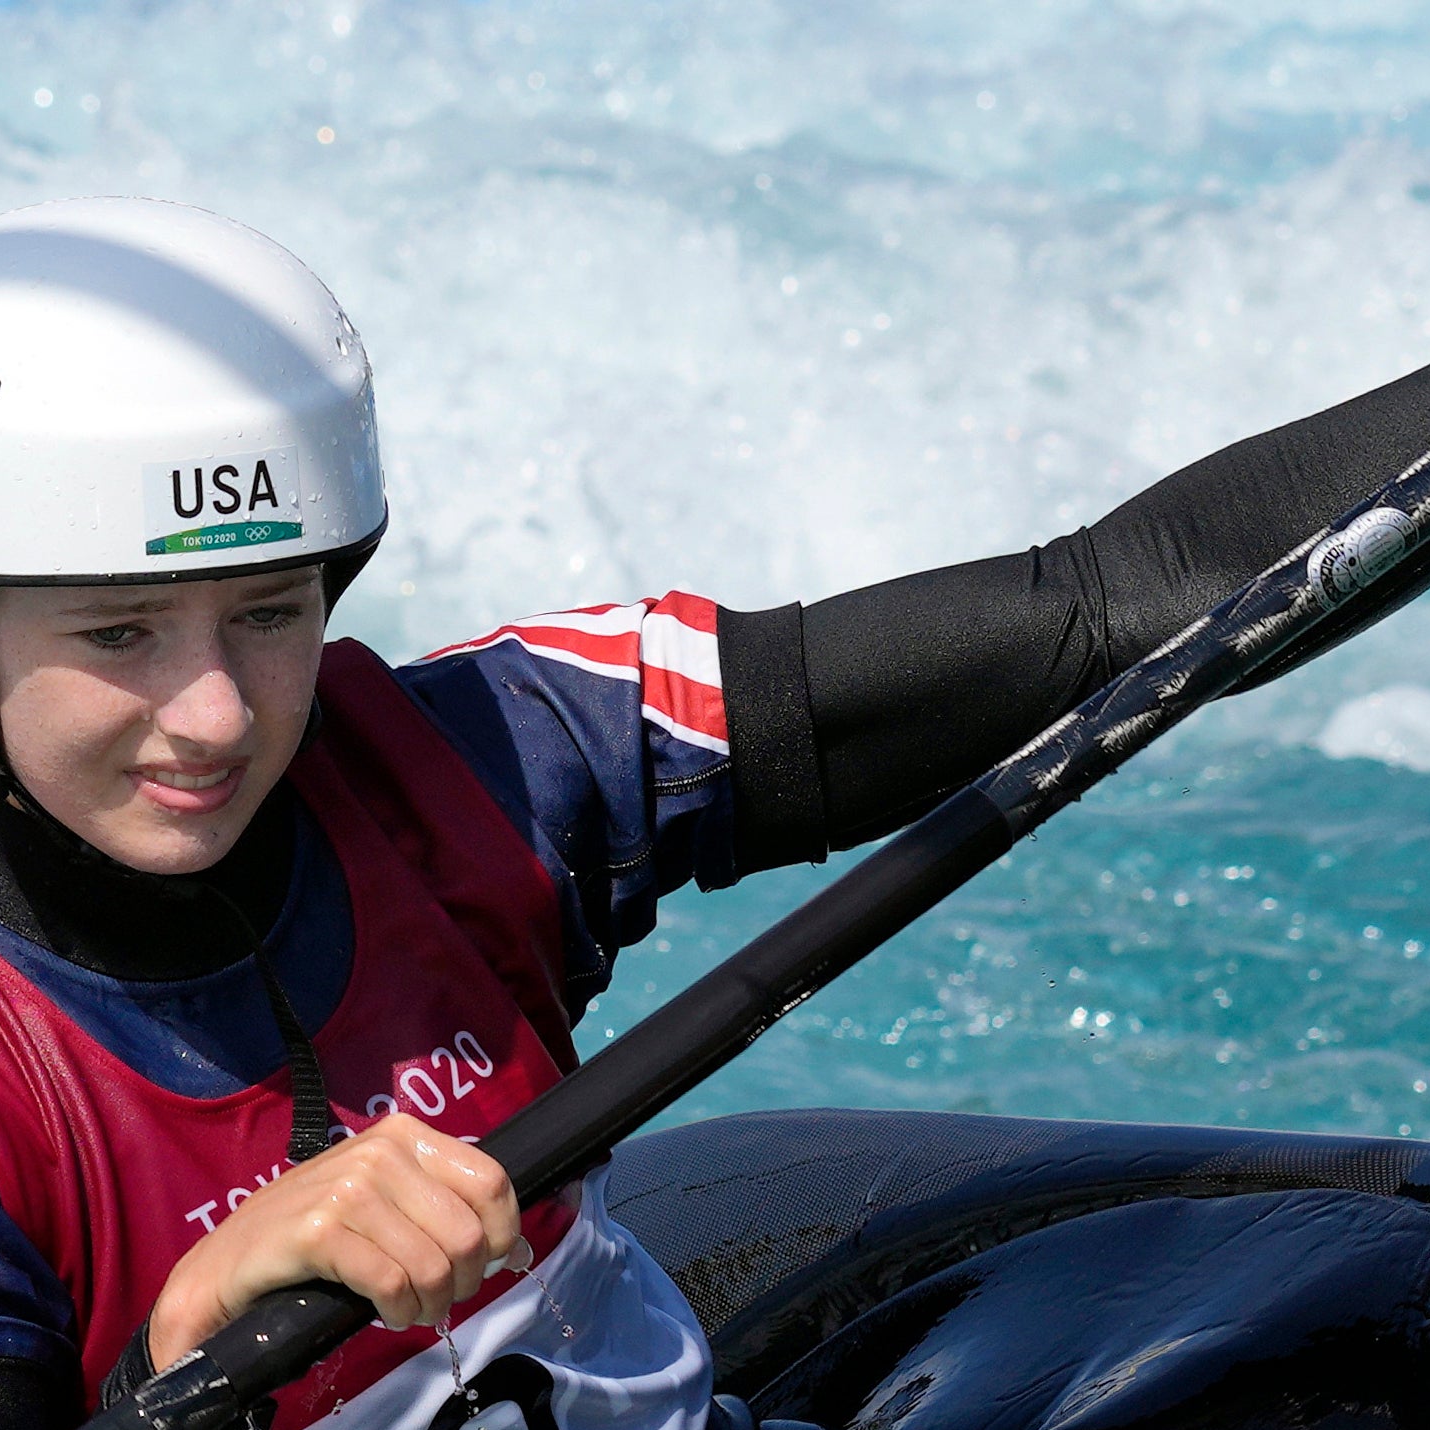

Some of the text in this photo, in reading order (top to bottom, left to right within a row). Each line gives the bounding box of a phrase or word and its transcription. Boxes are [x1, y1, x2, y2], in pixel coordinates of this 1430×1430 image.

[172, 459, 279, 518] USA
[181, 532, 237, 547] TOKYO 2020
